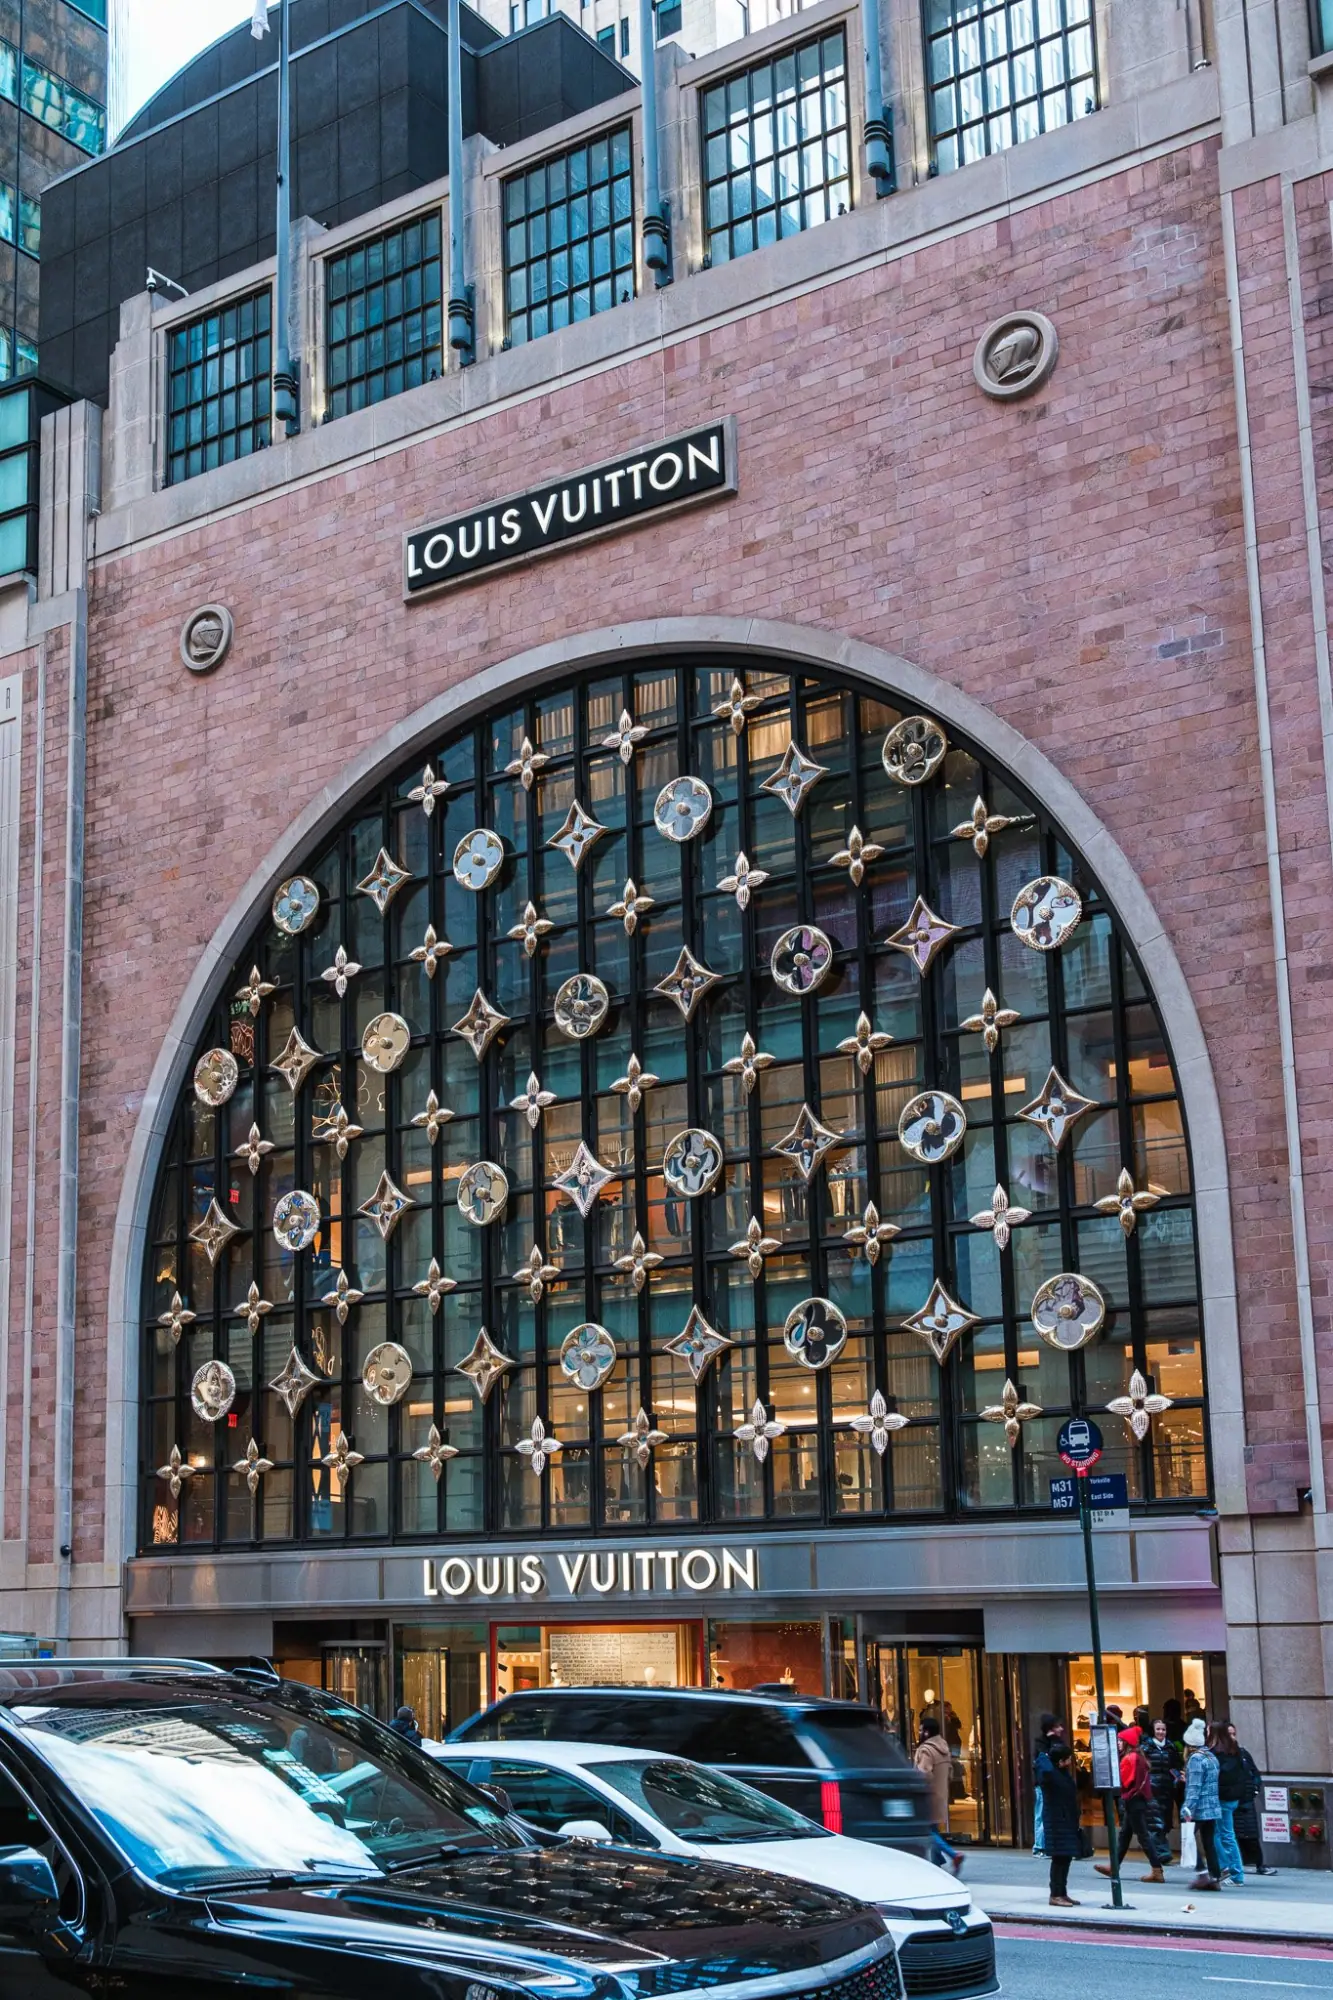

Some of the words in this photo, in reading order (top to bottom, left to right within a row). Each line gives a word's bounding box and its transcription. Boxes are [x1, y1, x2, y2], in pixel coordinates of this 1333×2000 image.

[407, 508, 523, 578] LOUIS
[530, 435, 720, 534] VUITTON
[1061, 1454, 1071, 1464] NO
[1071, 1451, 1099, 1467] STANDING
[1051, 1480, 1072, 1492] M31
[1053, 1496, 1074, 1508] M57
[423, 1555, 542, 1597] LOUIS
[557, 1548, 759, 1594] VUITTON
